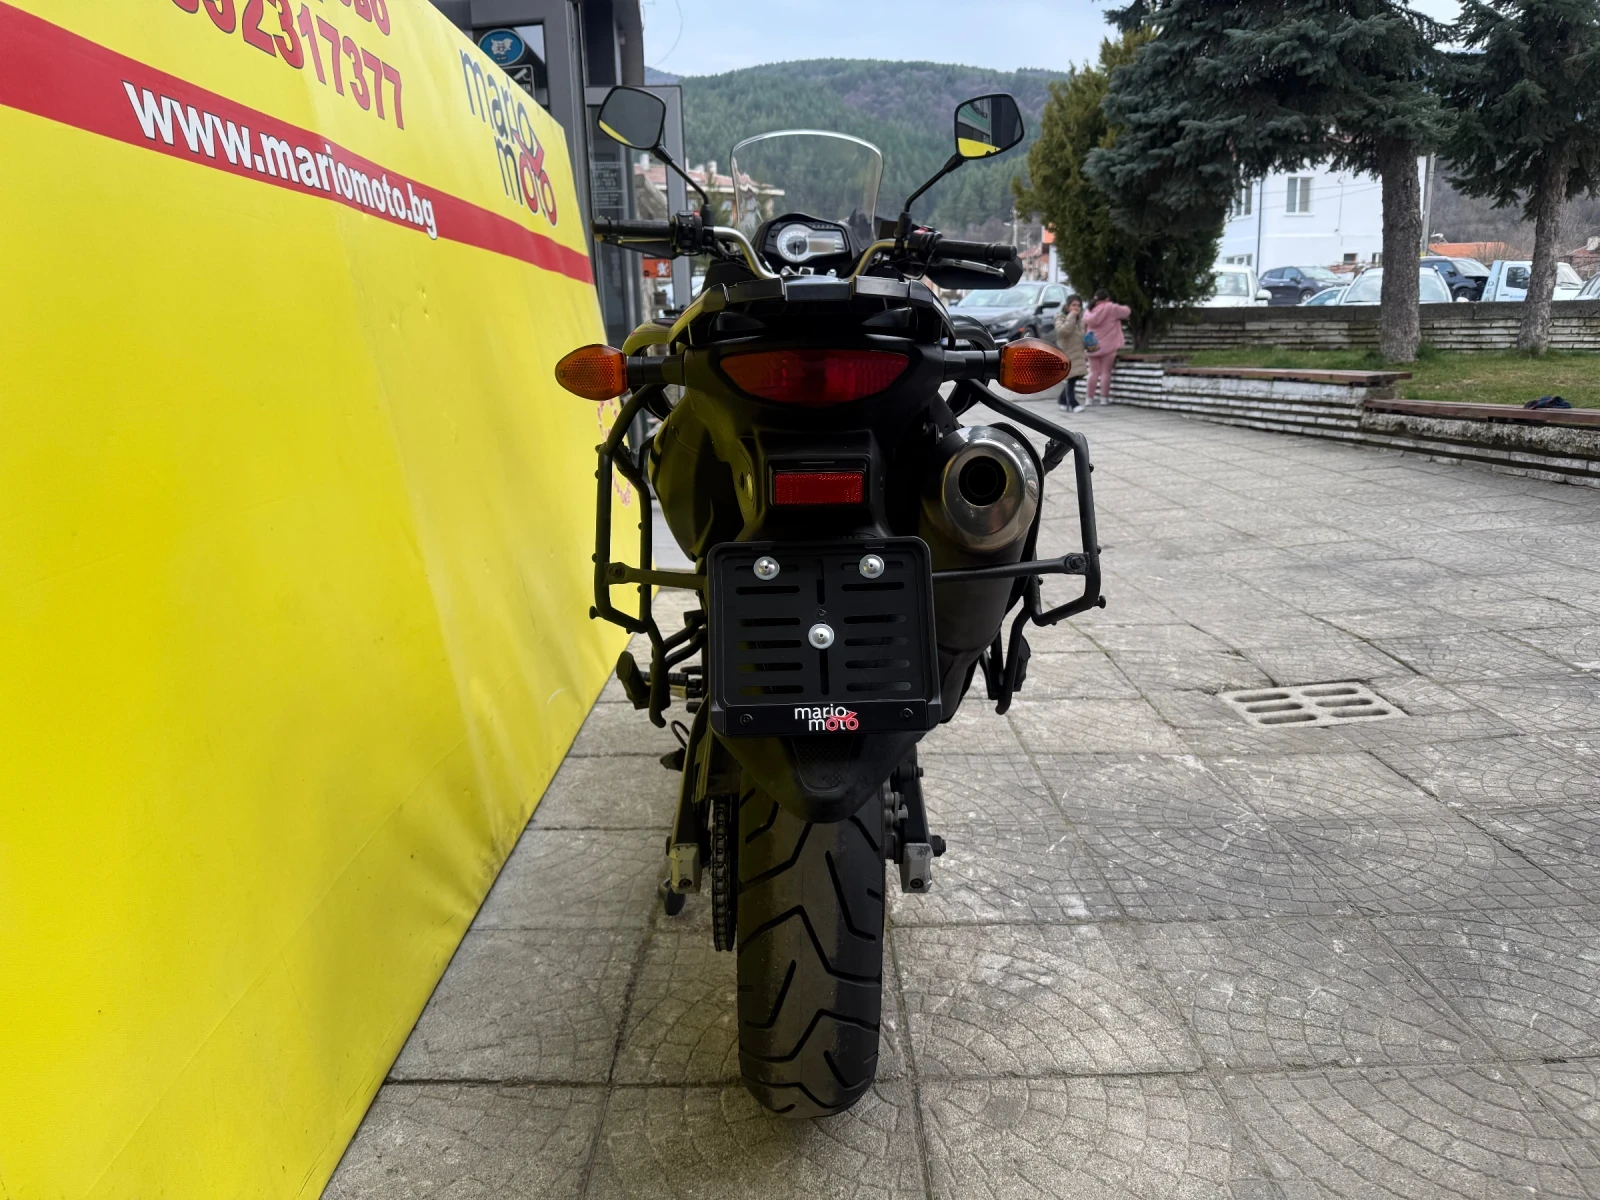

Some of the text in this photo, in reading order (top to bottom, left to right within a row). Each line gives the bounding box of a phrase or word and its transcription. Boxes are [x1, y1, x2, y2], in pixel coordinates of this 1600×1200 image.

[459, 48, 534, 156] mario
[121, 79, 438, 240] www.mariomoto.bg
[494, 135, 557, 226] moto
[794, 703, 847, 719] mario
[808, 718, 859, 731] moto
